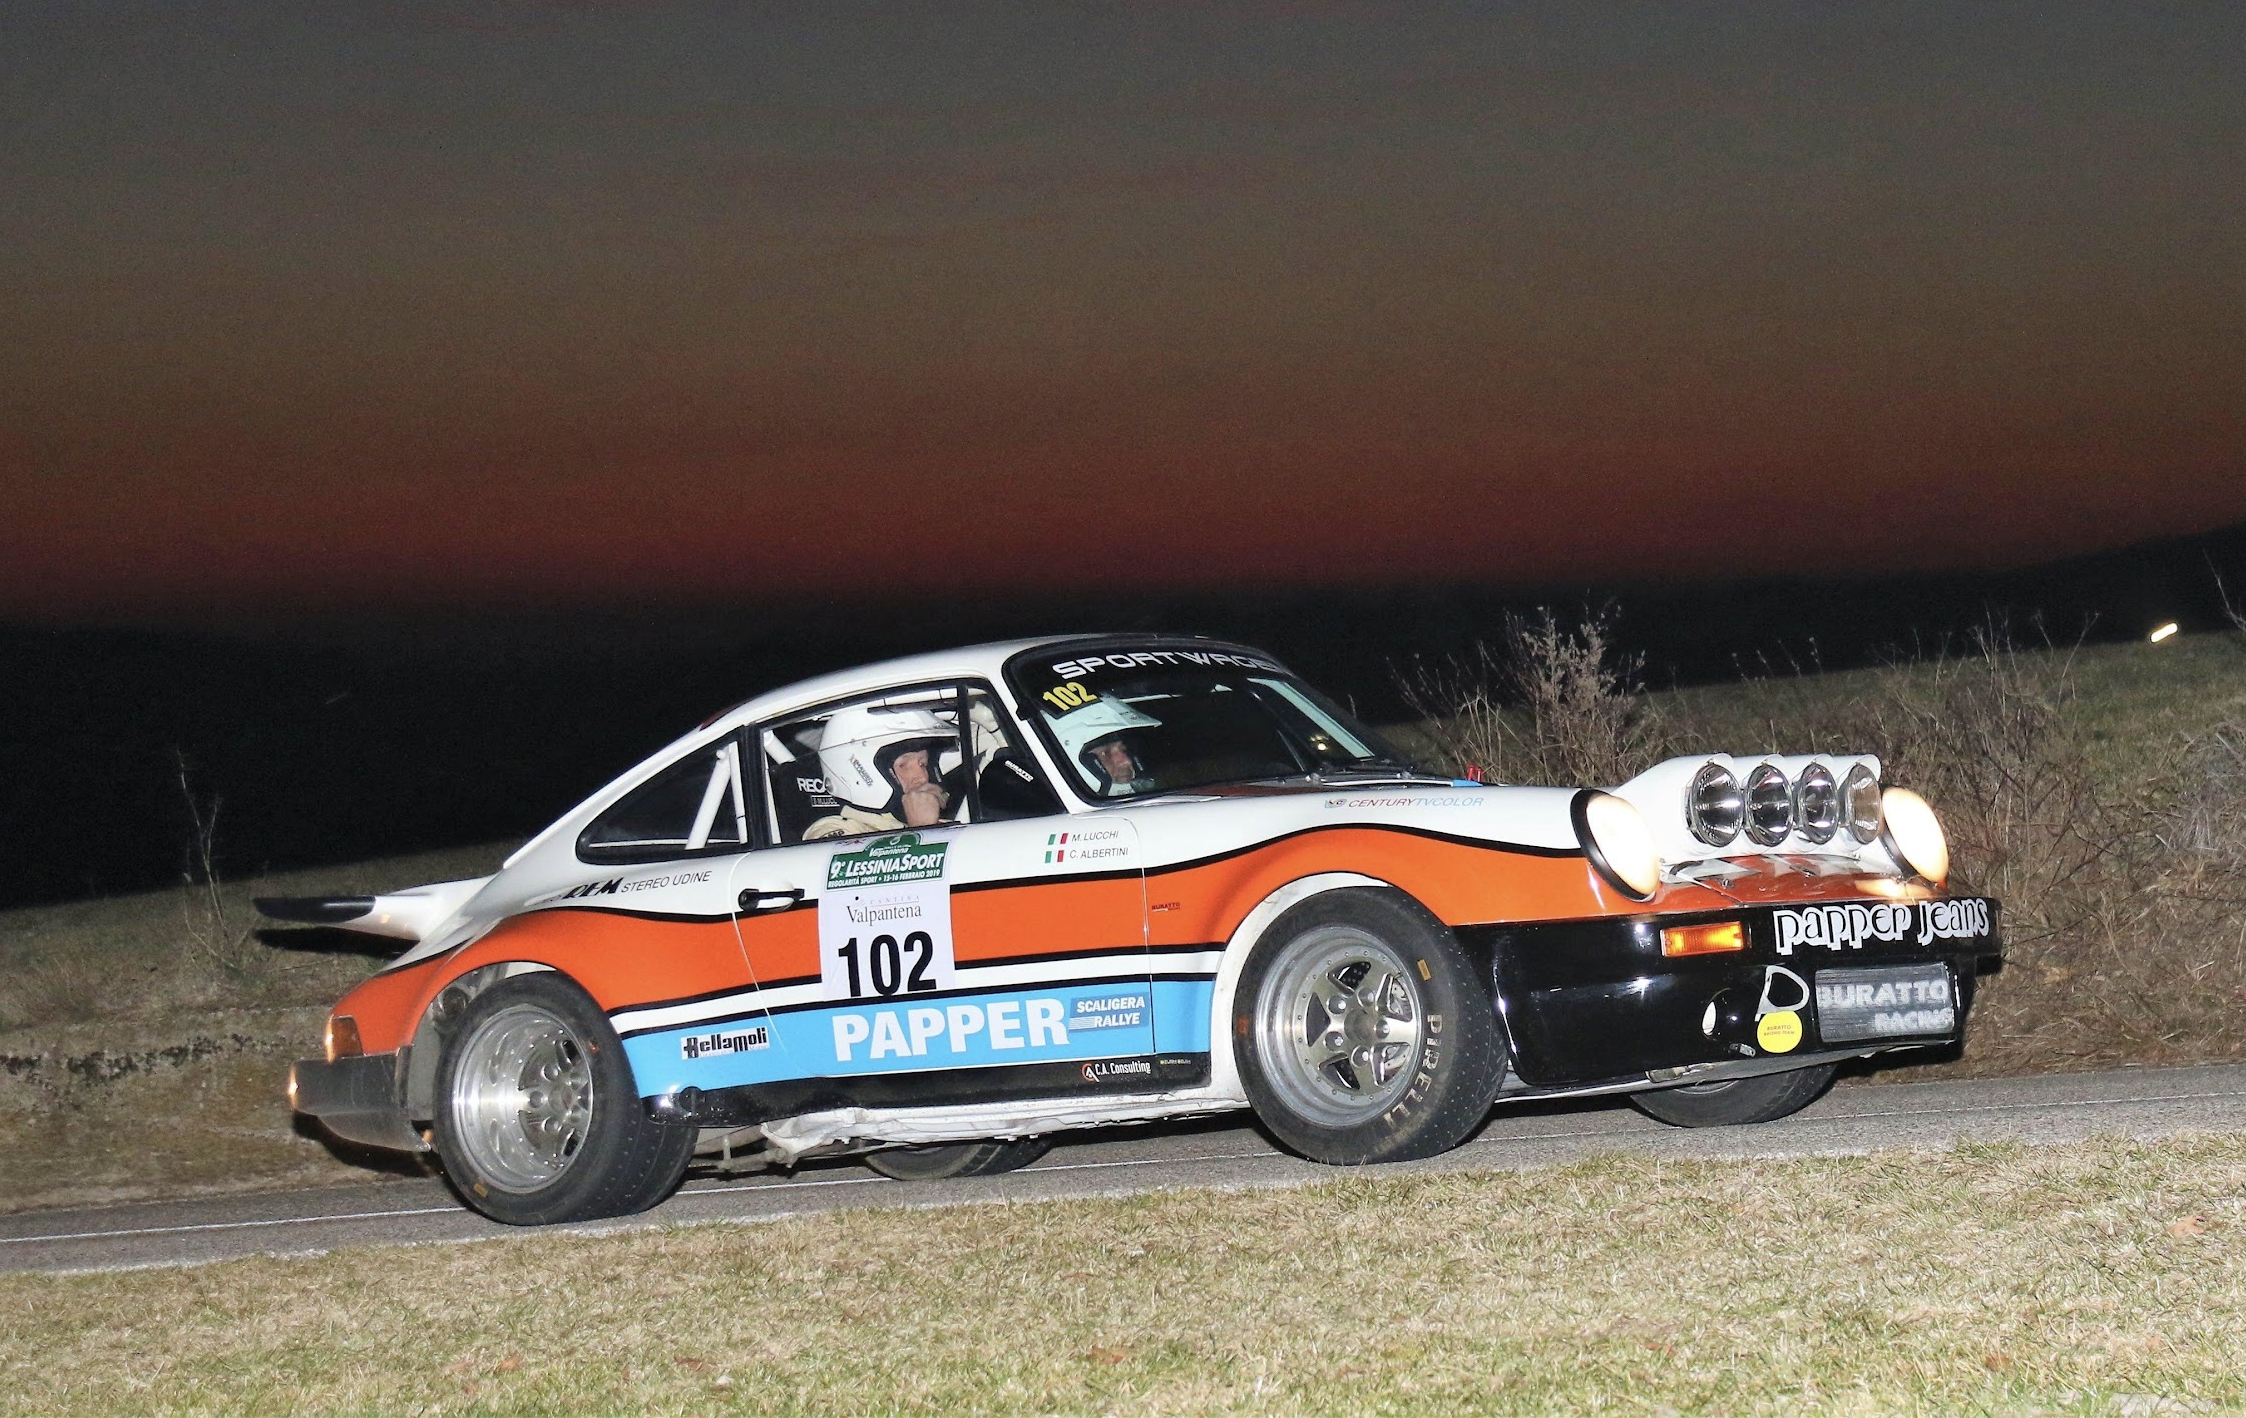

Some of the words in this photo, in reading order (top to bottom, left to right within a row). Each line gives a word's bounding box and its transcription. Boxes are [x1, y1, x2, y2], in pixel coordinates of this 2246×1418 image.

[1042, 681, 1098, 711] 102
[1083, 830, 1119, 841] LUCCHI
[1080, 847, 1129, 859] ALBERTINI
[621, 876, 670, 893] STEREO
[671, 870, 713, 886] UDINE
[860, 876, 878, 885] SPORT
[899, 871, 925, 881] FEBBRAIO
[925, 869, 941, 878] 2019
[846, 904, 922, 926] Valpantena
[838, 930, 937, 998] 102
[1076, 996, 1145, 1013] SCALIGERA
[1816, 979, 1949, 1008] BURATTO
[832, 998, 1070, 1062] PAPPER
[1094, 1012, 1141, 1028] RALLYE
[683, 1027, 767, 1059] Bellamoli
[1110, 1061, 1152, 1074] Consulting
[1383, 1014, 1443, 1130] PIRELLI
